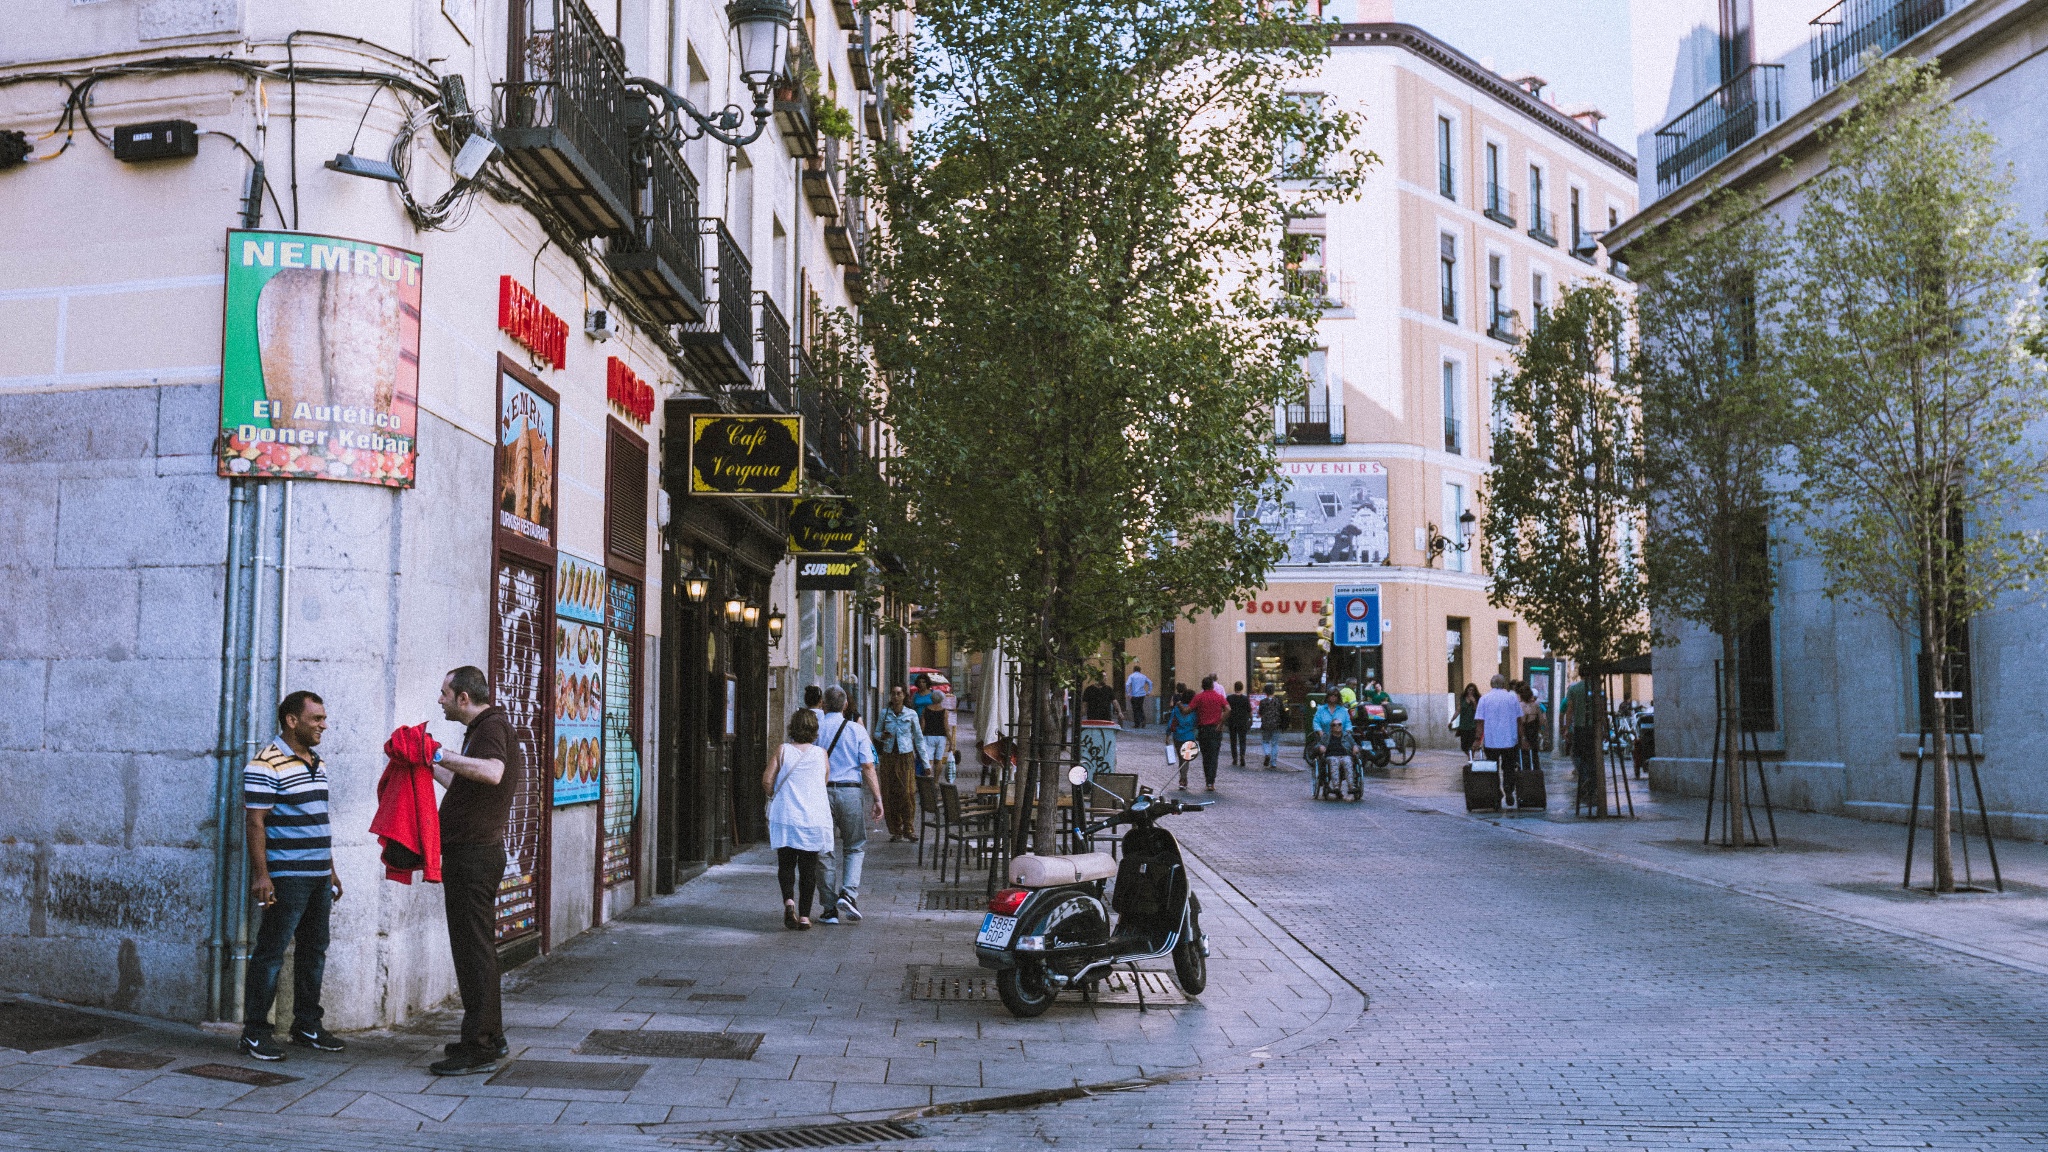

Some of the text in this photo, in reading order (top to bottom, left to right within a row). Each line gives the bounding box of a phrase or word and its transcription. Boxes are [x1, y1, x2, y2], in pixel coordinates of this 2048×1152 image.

[243, 241, 420, 286] NEMRUT
[253, 400, 281, 419] El
[238, 424, 409, 455] Doner Kebap
[726, 424, 767, 456] Café
[712, 457, 781, 485] Vergara
[1265, 463, 1380, 474] OUVENIRS
[803, 527, 853, 547] Vergara
[801, 562, 858, 576] SUBWAY
[1247, 601, 1322, 614] SOUVE
[991, 917, 1015, 931] 5885
[986, 930, 1004, 942] GDP
